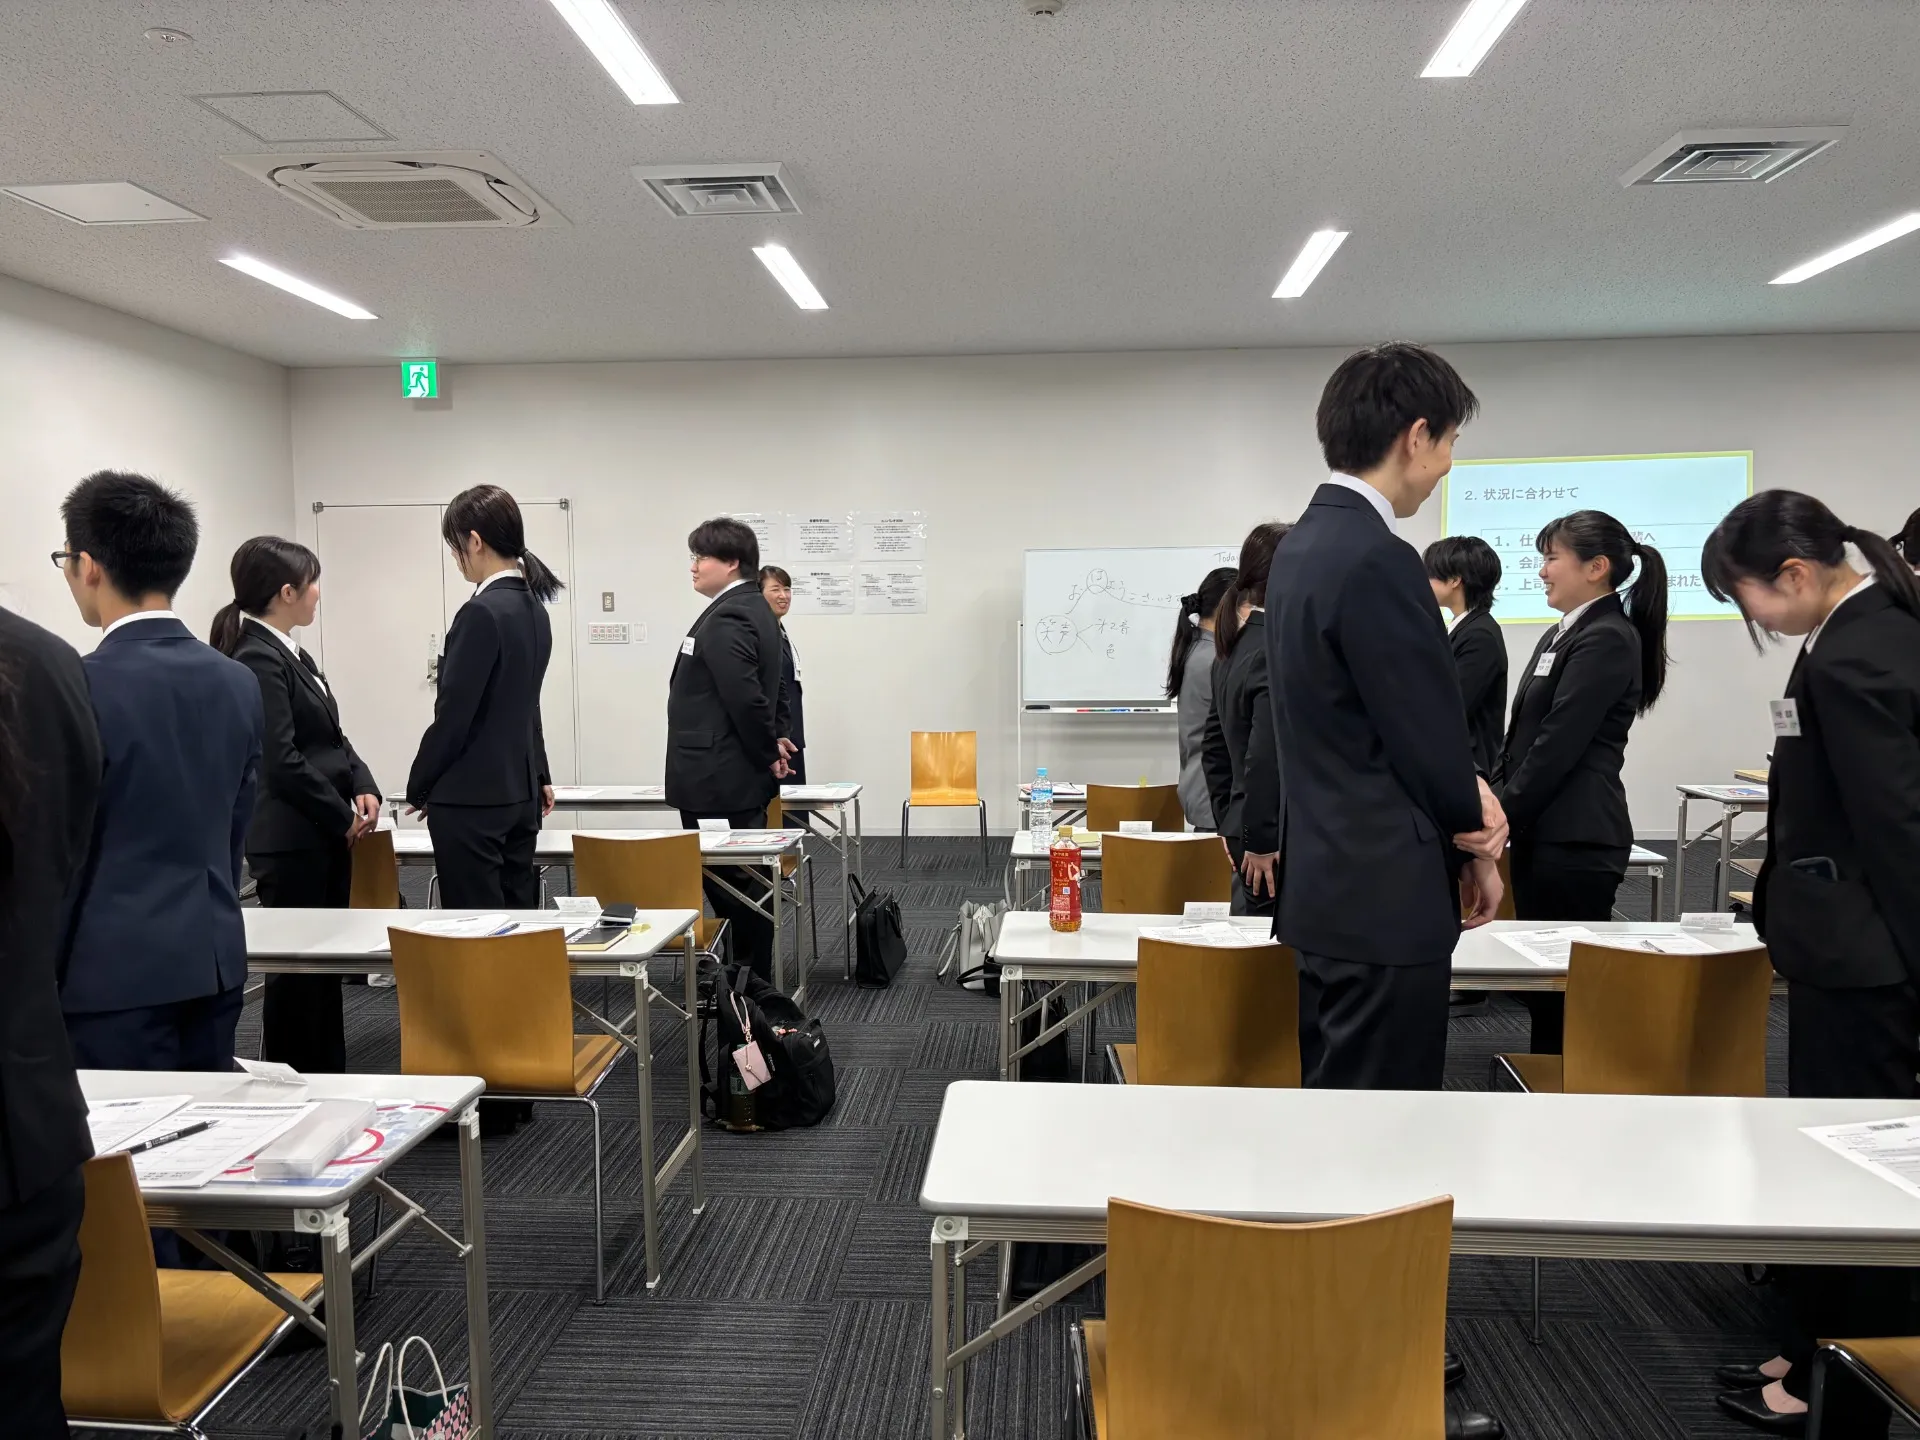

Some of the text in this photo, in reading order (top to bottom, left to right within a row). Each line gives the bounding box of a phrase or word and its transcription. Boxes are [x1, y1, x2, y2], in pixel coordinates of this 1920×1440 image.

[1483, 486, 1580, 501] 状況に合わせて
